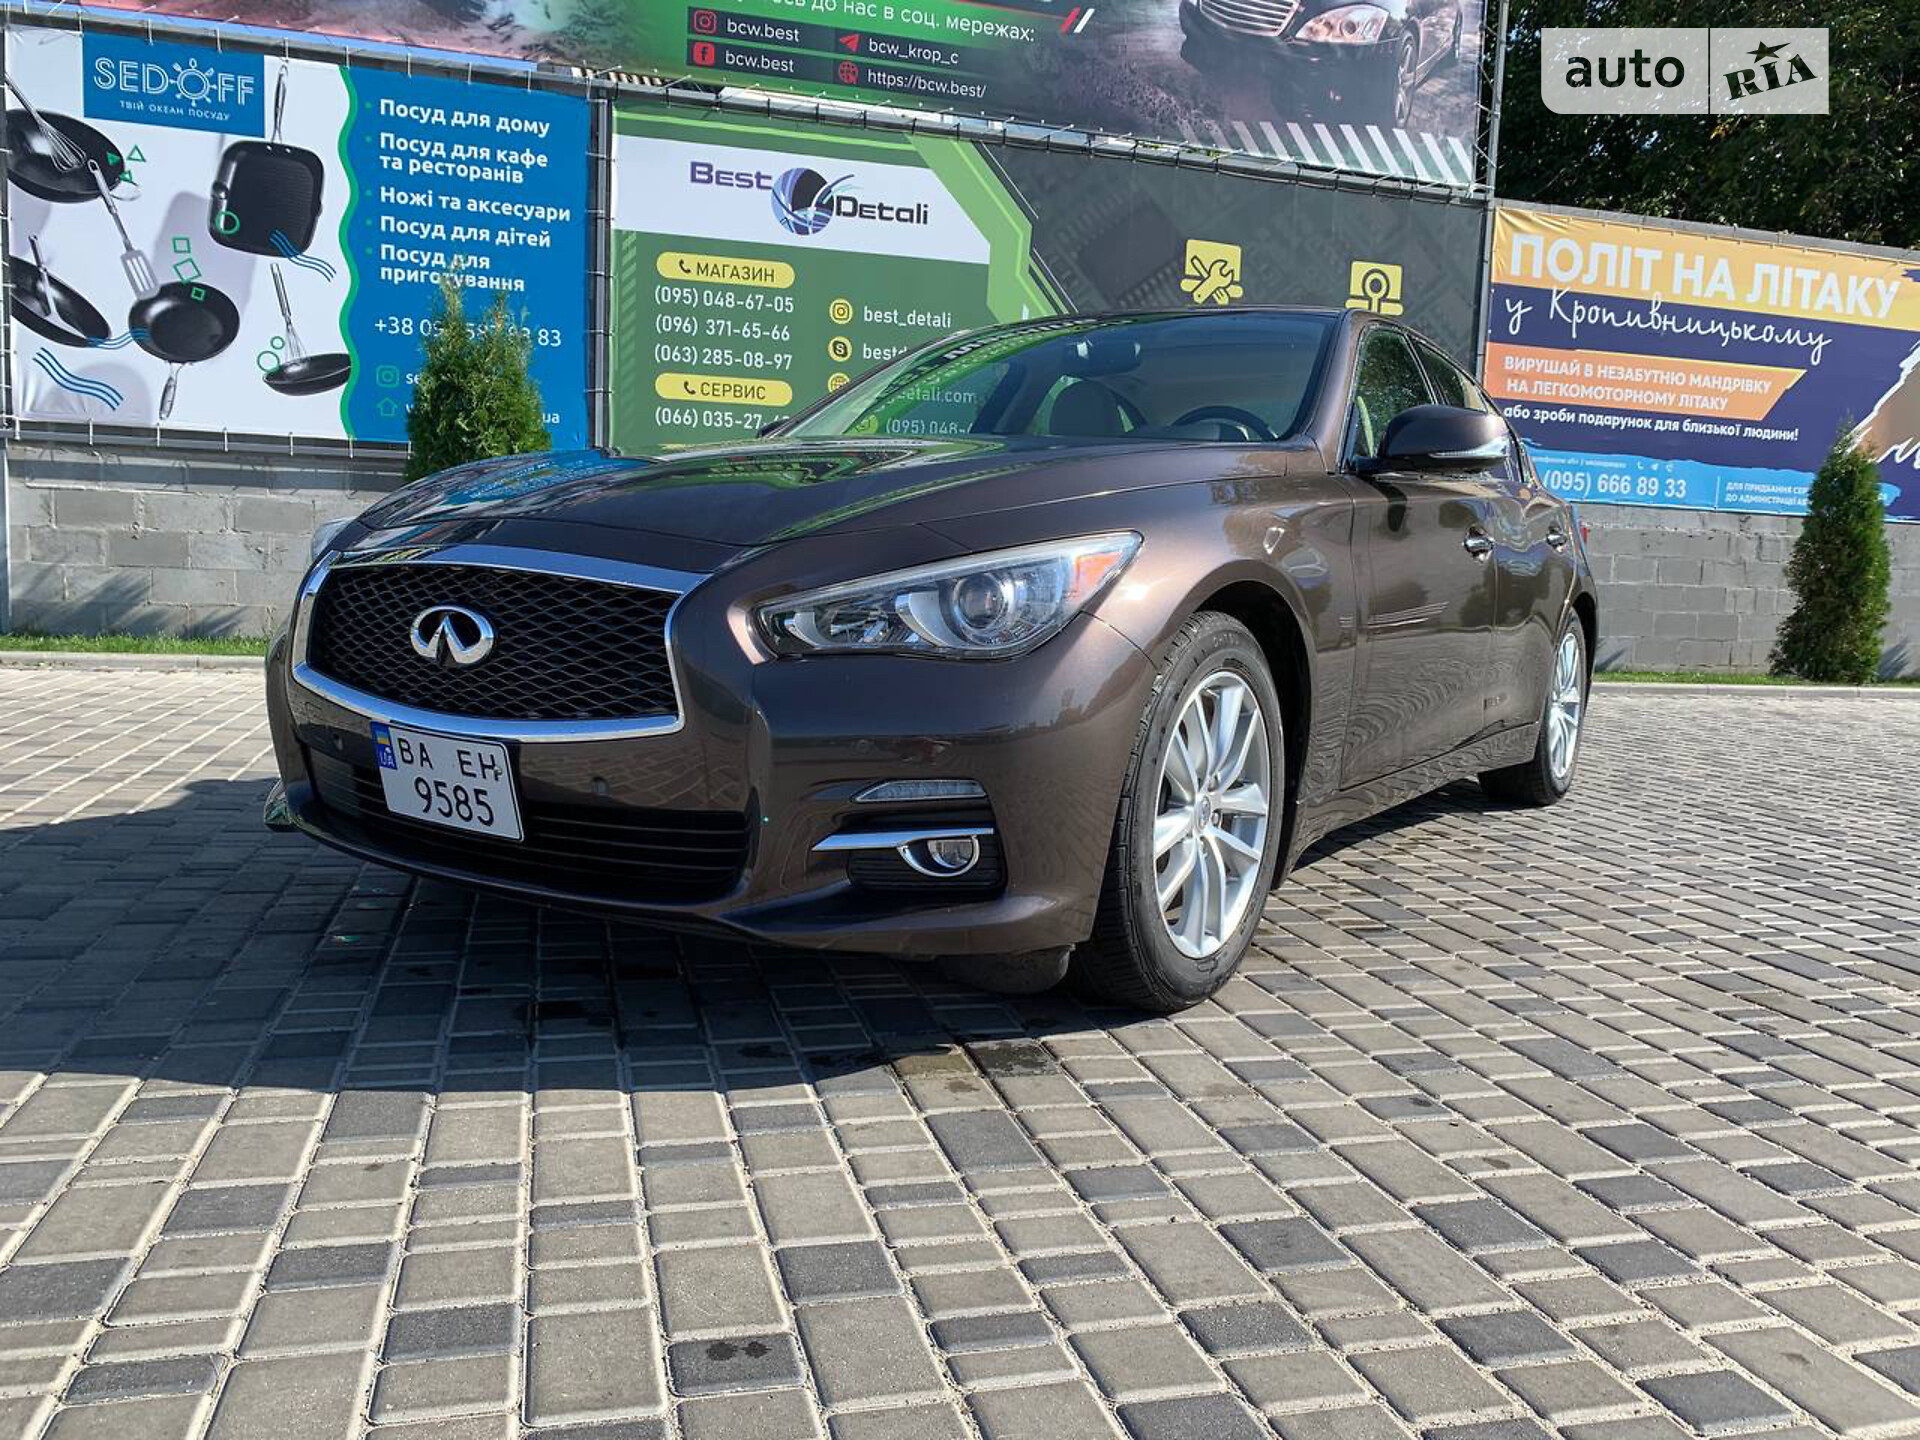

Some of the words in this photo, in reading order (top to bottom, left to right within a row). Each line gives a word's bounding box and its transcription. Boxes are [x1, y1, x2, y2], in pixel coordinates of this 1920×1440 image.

[727, 18, 800, 42] bcw.best
[844, 1, 877, 17] нас
[884, 7, 894, 20] в
[900, 9, 940, 27] соц.
[946, 16, 1035, 42] мережах:
[725, 50, 794, 73] bcw.best
[869, 38, 959, 65] bcw_krop_c
[867, 69, 987, 98] https://bcw.best/
[119, 100, 144, 110] ТВІЙ
[149, 104, 184, 116] ОКЕАН
[188, 109, 231, 121] ПОСУДУ
[380, 98, 446, 125] Посуд
[451, 110, 491, 128] для
[496, 116, 550, 138] дому
[380, 132, 446, 158] Посуд
[451, 144, 490, 161] для
[496, 148, 548, 169] кафе
[380, 155, 402, 170] та
[409, 159, 524, 184] ресторанів
[380, 186, 432, 207] Ножі
[438, 194, 461, 210] та
[467, 197, 571, 222] аксесуари
[689, 161, 774, 191] Best
[835, 195, 929, 225] Detali
[380, 215, 446, 240] Посуд
[451, 224, 490, 242] для
[496, 227, 551, 247] дітей
[380, 244, 446, 269] Посуд
[451, 253, 490, 270] для
[696, 261, 775, 283] МАГАЗИН
[1511, 233, 1661, 291] ПОЛІТ
[1673, 252, 1736, 302] НА
[1746, 263, 1901, 319] ЛІТАКУ
[654, 285, 699, 308] (095)
[703, 289, 794, 314] 048-67-05
[655, 313, 698, 336] (096)
[705, 318, 790, 342] 371-65-66
[864, 306, 951, 328] best_detali
[1506, 294, 1533, 334] у
[1549, 287, 1833, 367] Кропивницькому
[375, 316, 413, 336] +38
[538, 328, 562, 348] 83
[654, 344, 698, 367] (063)
[702, 347, 793, 371] 285-08-97
[1505, 355, 1580, 377] ВИРУШАЙ
[1584, 361, 1594, 376] В
[1597, 365, 1685, 386] НЕЗАБУТНЮ
[1690, 374, 1772, 395] МАНДРІВКУ
[700, 381, 766, 400] СЕРВИС
[1506, 378, 1529, 394] НА
[1532, 380, 1676, 405] ЛЕГКОМОТОРНОМУ
[1679, 394, 1728, 411] ЛІТАКУ
[655, 406, 698, 428] (066)
[1503, 405, 1530, 419] або
[1533, 408, 1576, 424] зроби
[1579, 412, 1651, 431] подарунок
[1654, 420, 1679, 433] для
[1682, 418, 1741, 437] близької
[1743, 426, 1799, 442] людини!
[1543, 470, 1591, 496] (095)
[1597, 474, 1631, 494] 666
[1636, 476, 1659, 496] 89
[1664, 479, 1687, 498] 33
[414, 776, 495, 827] 9585
